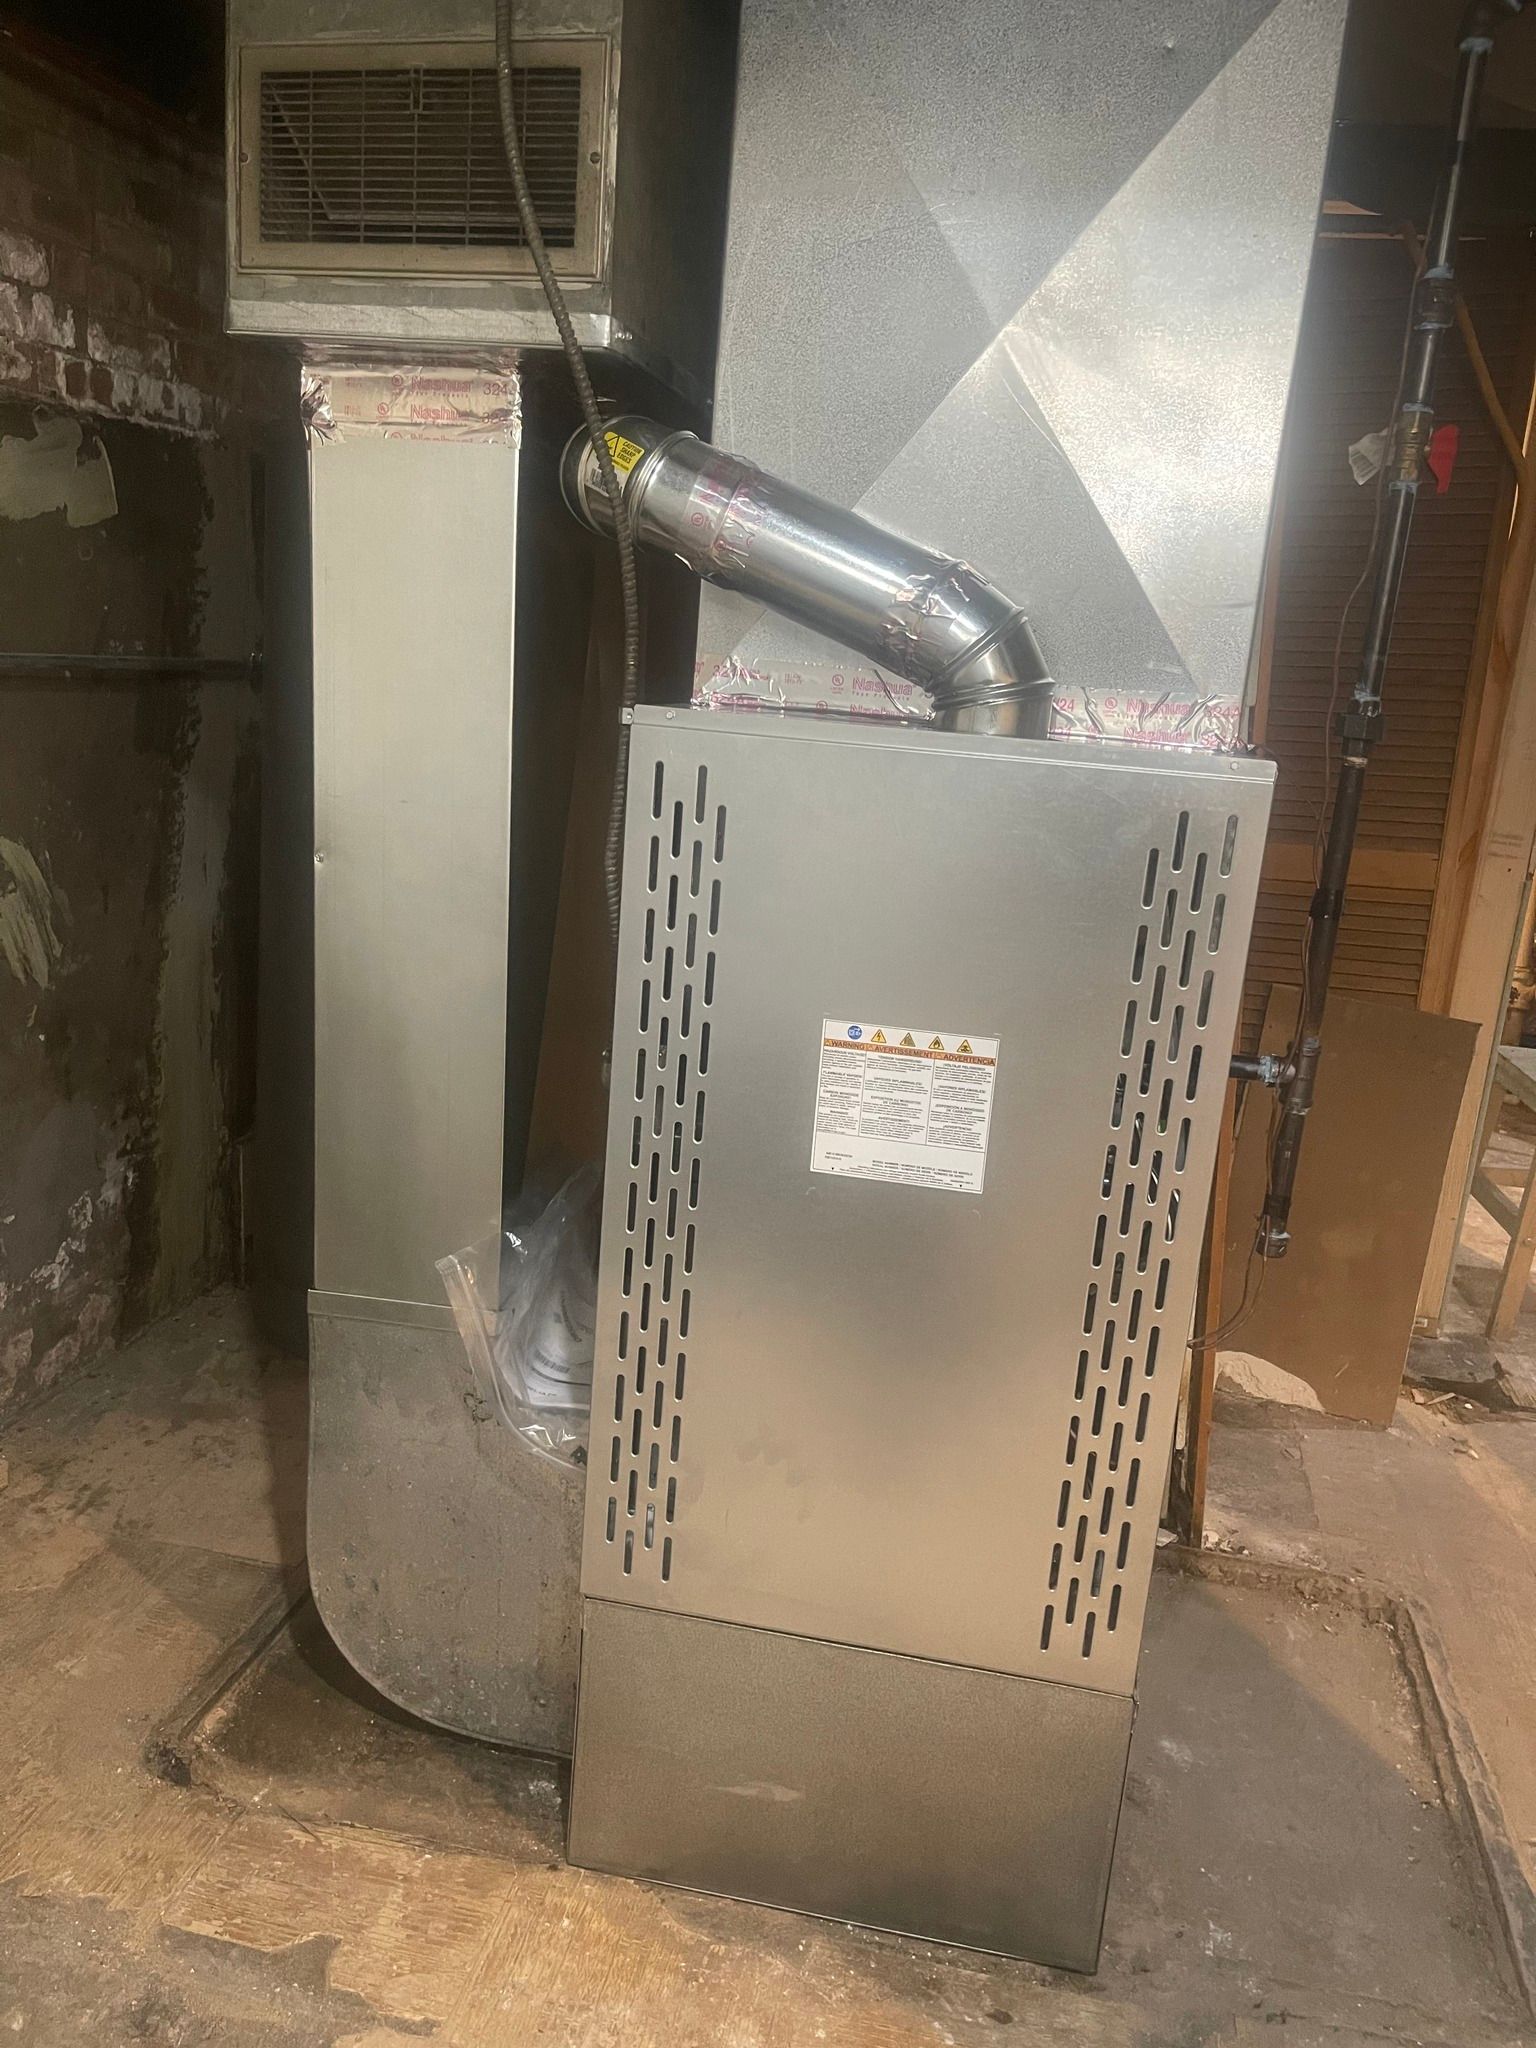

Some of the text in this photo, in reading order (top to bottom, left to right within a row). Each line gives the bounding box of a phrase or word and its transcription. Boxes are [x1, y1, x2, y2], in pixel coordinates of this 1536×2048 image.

[411, 375, 471, 393] Nashua
[622, 441, 642, 454] CAUTION
[831, 1041, 996, 1066] WARNING AVERTISSEMENT ADVERTENCIA
